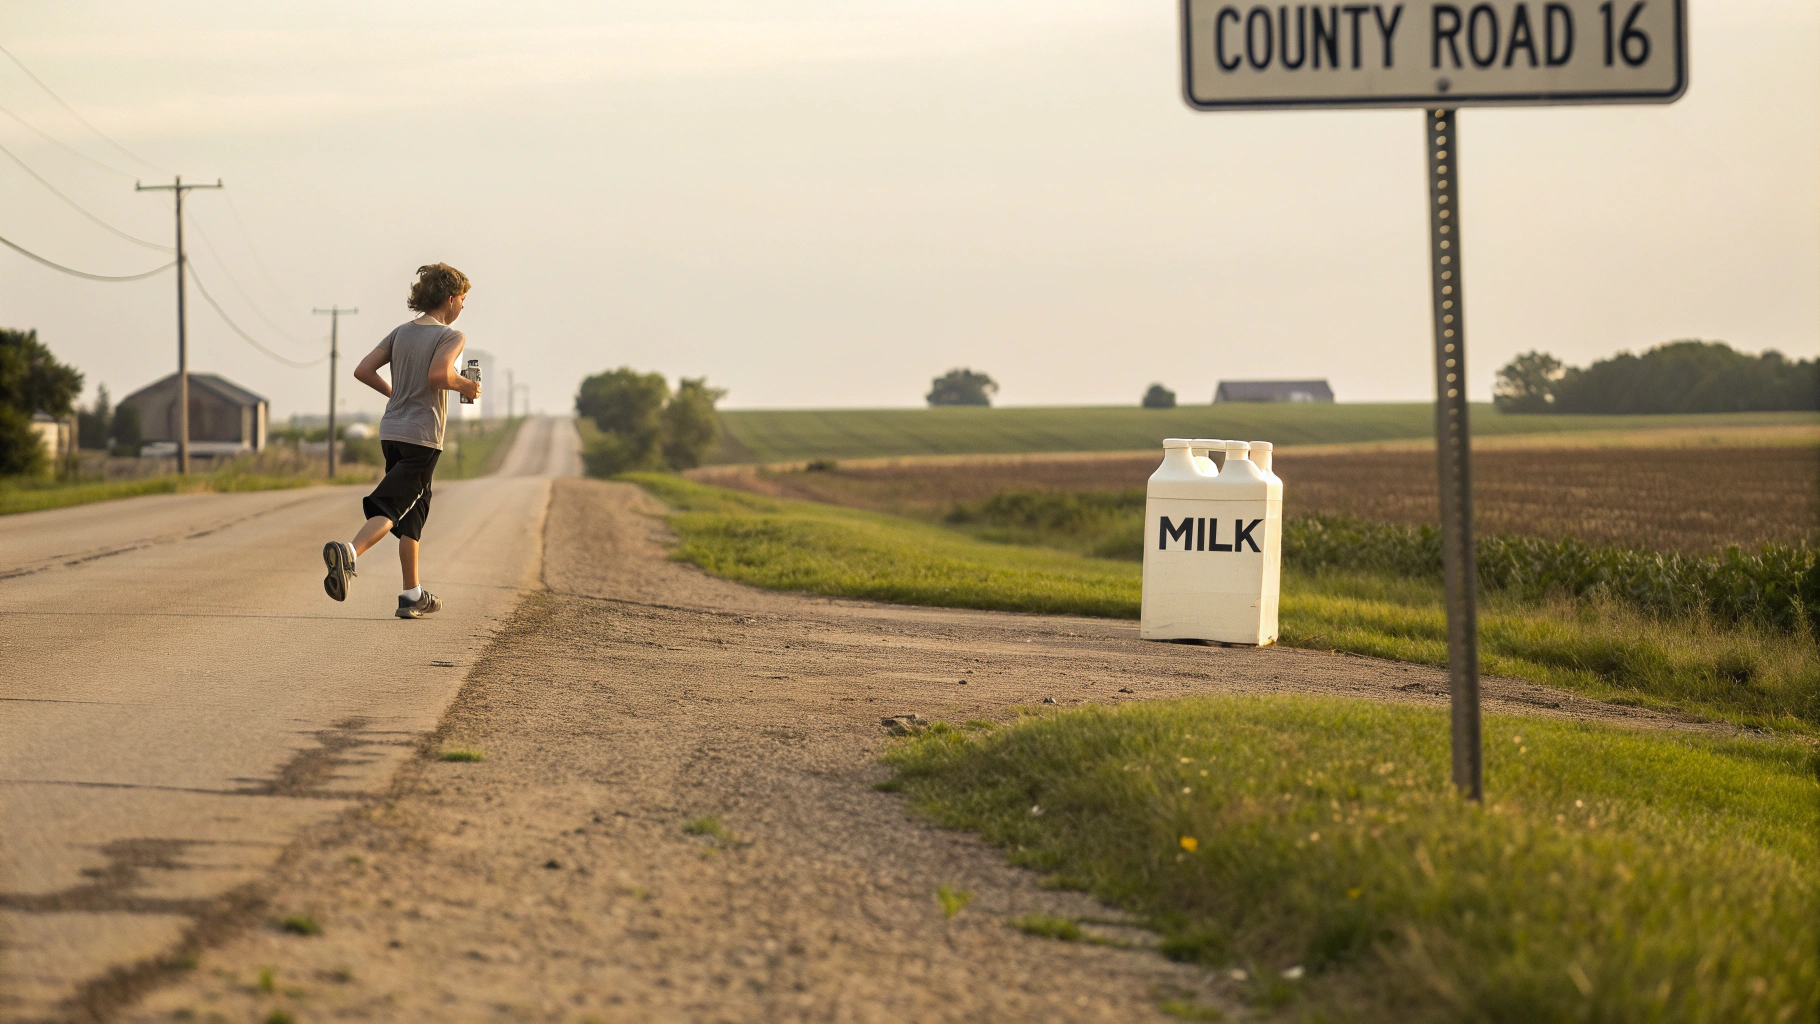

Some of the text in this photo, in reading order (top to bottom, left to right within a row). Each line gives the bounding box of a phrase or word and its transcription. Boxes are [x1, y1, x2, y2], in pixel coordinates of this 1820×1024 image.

[1215, 0, 1652, 72] COUNTY ROAD 16
[1158, 516, 1264, 552] MILK
